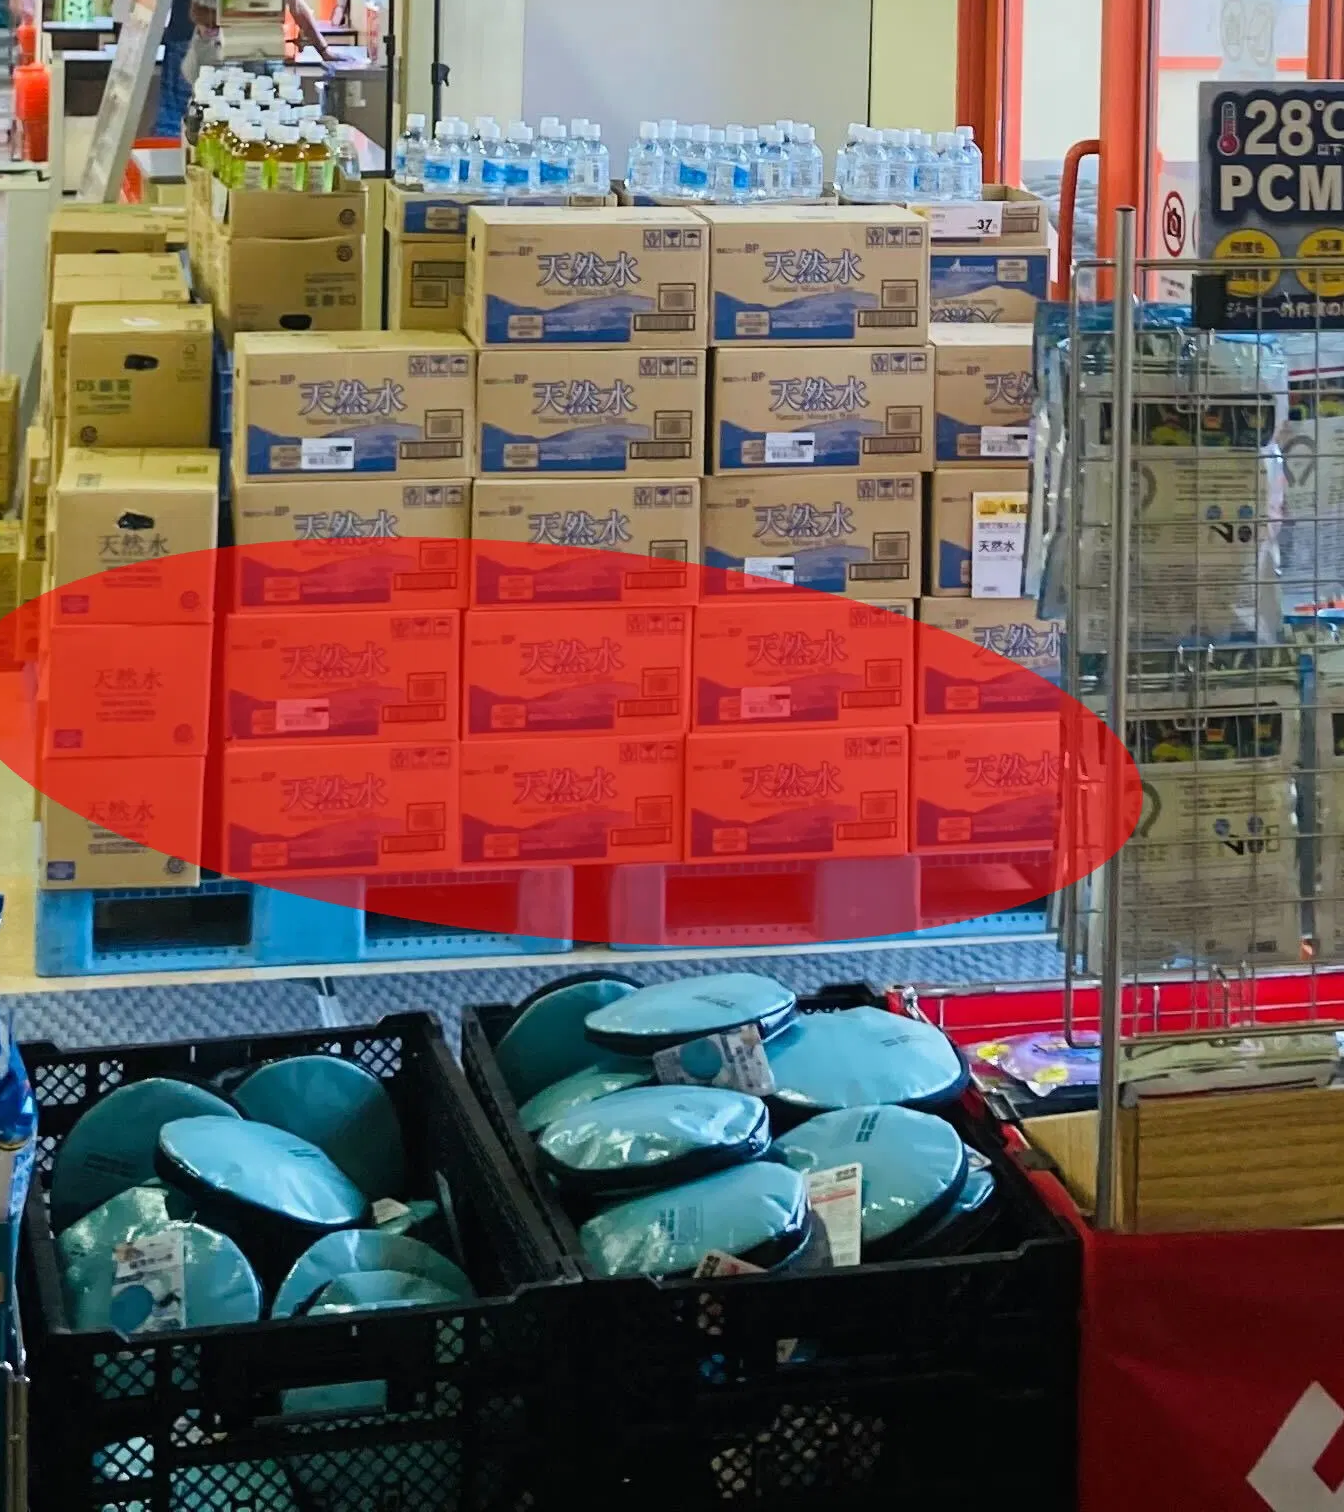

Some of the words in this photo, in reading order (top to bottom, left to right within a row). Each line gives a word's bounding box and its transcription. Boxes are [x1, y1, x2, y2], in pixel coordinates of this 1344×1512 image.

[976, 219, 993, 230] 37
[536, 251, 641, 288] 天然水
[763, 248, 865, 285] 天然水
[298, 379, 407, 416] 天然水
[532, 381, 639, 416] 天然水
[769, 376, 870, 413] 天然水
[293, 509, 402, 547] 天然水
[528, 508, 633, 547] 天然水
[753, 501, 856, 538] 天然水
[97, 533, 171, 558] 天然水
[978, 540, 1016, 553] 天然水
[280, 641, 391, 681] 天然水
[519, 637, 626, 676] 天然水
[746, 629, 849, 668] 天然水
[512, 766, 618, 806] 天然水
[740, 761, 844, 800] 天然水
[965, 752, 1060, 790] 天然水
[280, 772, 390, 813] 天然水
[87, 801, 157, 822] 天然水
